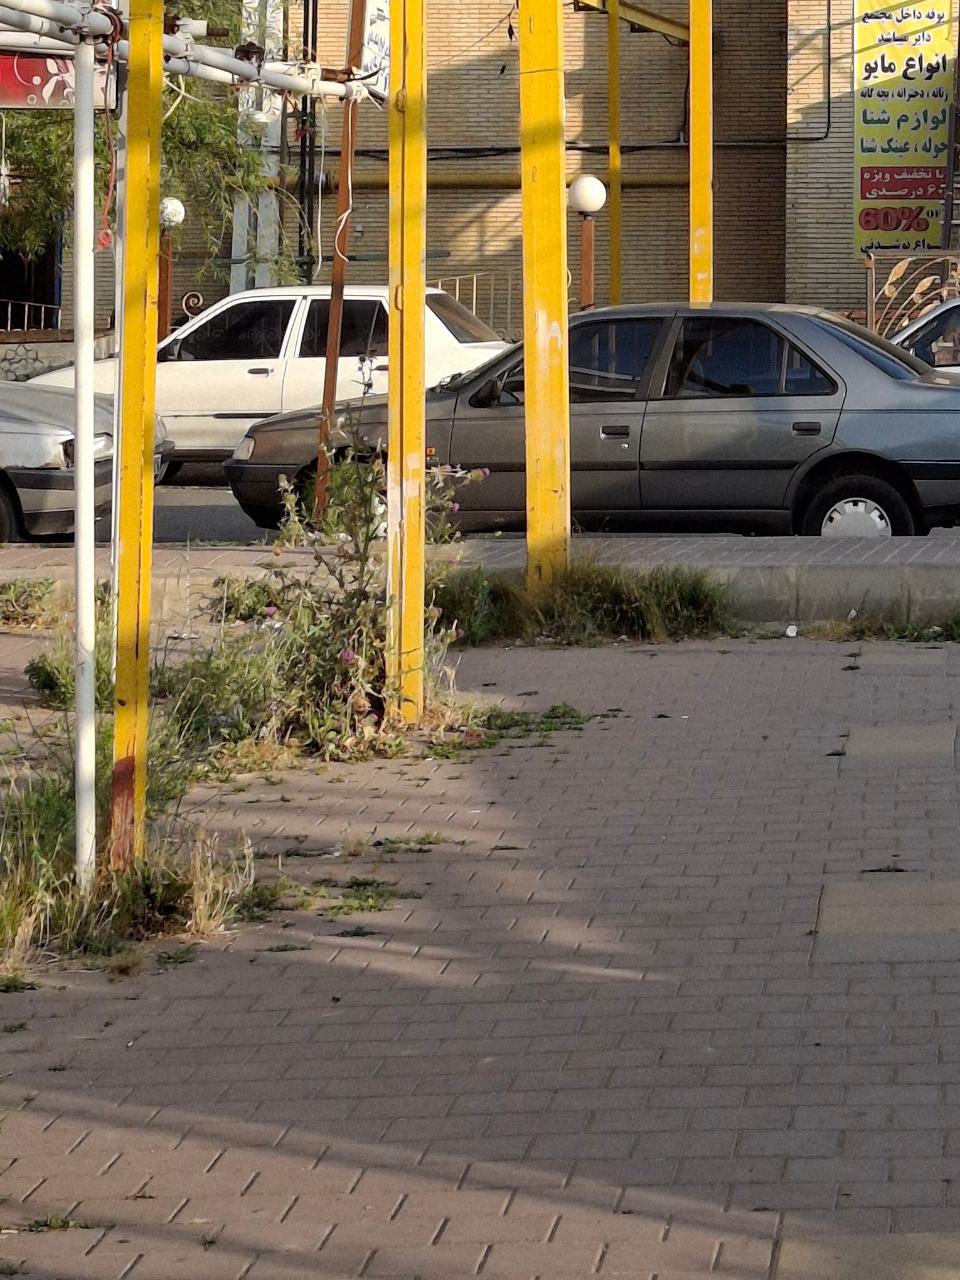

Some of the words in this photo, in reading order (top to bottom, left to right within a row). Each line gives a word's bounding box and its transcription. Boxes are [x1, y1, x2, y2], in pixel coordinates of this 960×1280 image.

[895, 8, 922, 23] داخل
[912, 32, 931, 46] دایر
[862, 53, 896, 80] مایو
[902, 53, 947, 80] انواع
[862, 108, 891, 125] شنا
[896, 109, 947, 131] لوازم
[880, 137, 911, 158] عینک
[863, 169, 891, 183] ویژه
[894, 168, 933, 182] تخفیف
[865, 185, 924, 200] درصدی
[859, 206, 929, 232] 60%
